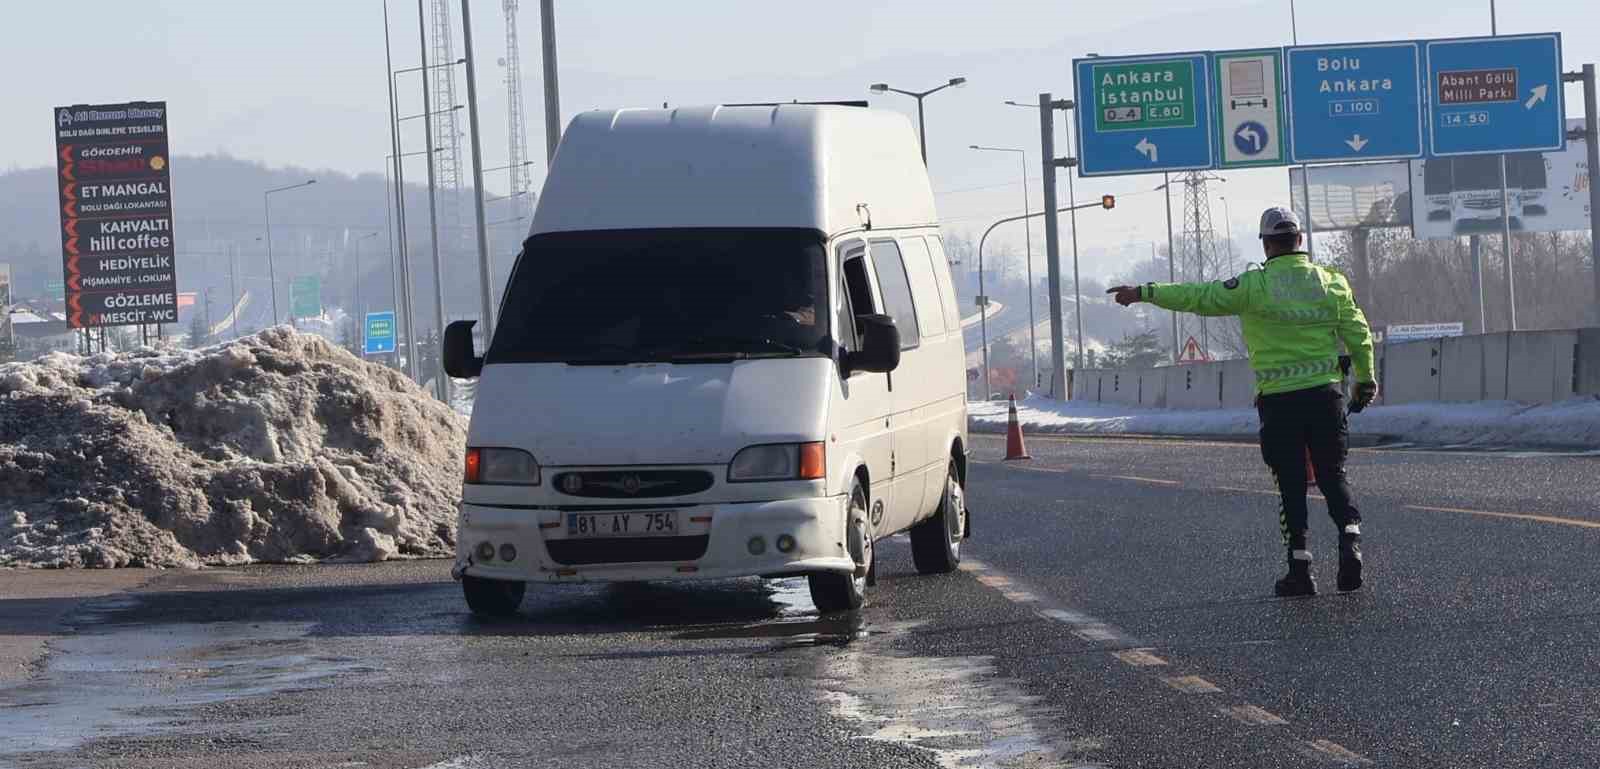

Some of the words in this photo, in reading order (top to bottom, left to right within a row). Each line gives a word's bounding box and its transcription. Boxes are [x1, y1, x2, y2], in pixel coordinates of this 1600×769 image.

[1317, 57, 1360, 71] Bolu
[1103, 71, 1174, 86] Ankara
[1319, 78, 1392, 93] Ankara
[1441, 75, 1479, 86] Abant
[81, 145, 142, 157] GÖKDEMİR
[82, 186, 98, 198] ET
[102, 182, 166, 197] MANGAL
[80, 204, 101, 212] BOLU
[100, 219, 169, 233] KAHVALTI
[90, 236, 115, 251] hill
[118, 234, 169, 250] coffee
[100, 254, 170, 271] HEDİYELİK
[138, 273, 171, 283] LOKUM
[104, 293, 173, 308] GÖZLEME
[100, 309, 146, 324] MESCİT
[578, 515, 596, 534] 81
[612, 514, 630, 533] AY
[644, 513, 673, 531] 754
